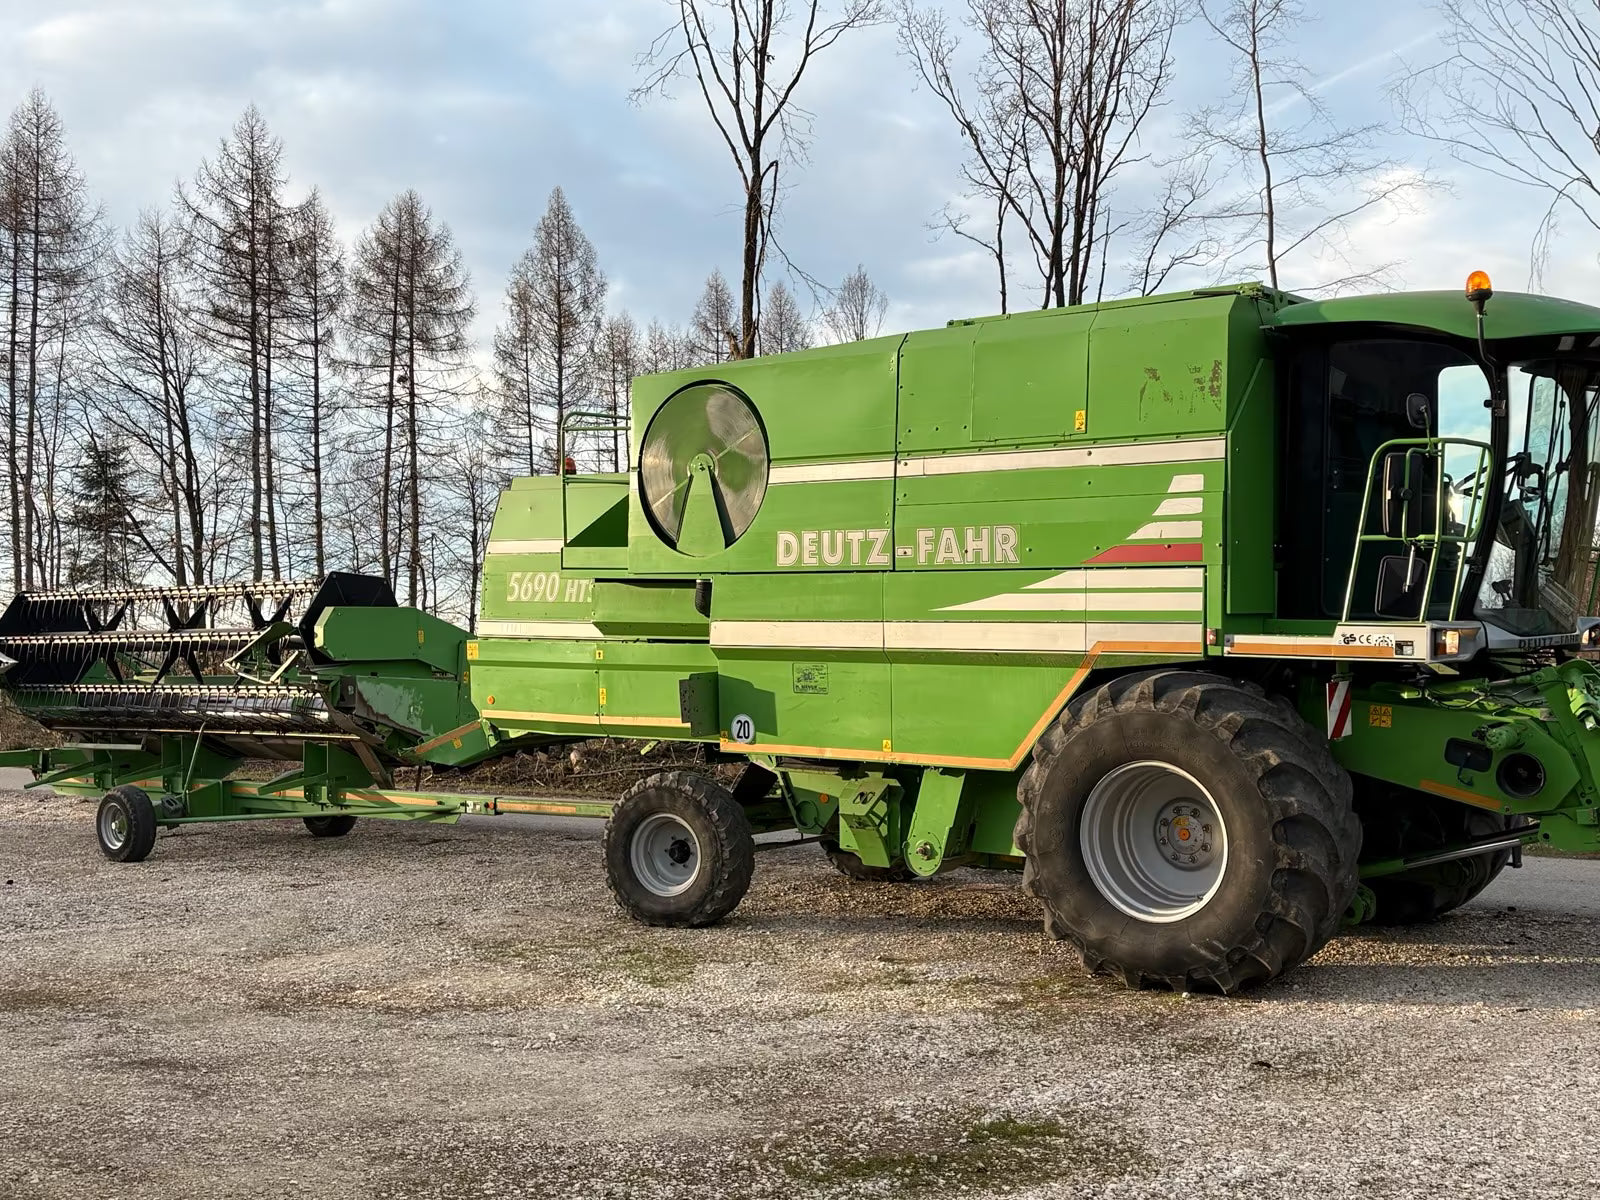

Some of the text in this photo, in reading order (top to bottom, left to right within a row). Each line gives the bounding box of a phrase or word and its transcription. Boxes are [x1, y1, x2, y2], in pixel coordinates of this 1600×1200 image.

[777, 525, 1021, 566] DEUTZ-FAHR
[506, 572, 560, 602] 5690
[1343, 634, 1372, 645] GS CE
[736, 719, 750, 740] 20
